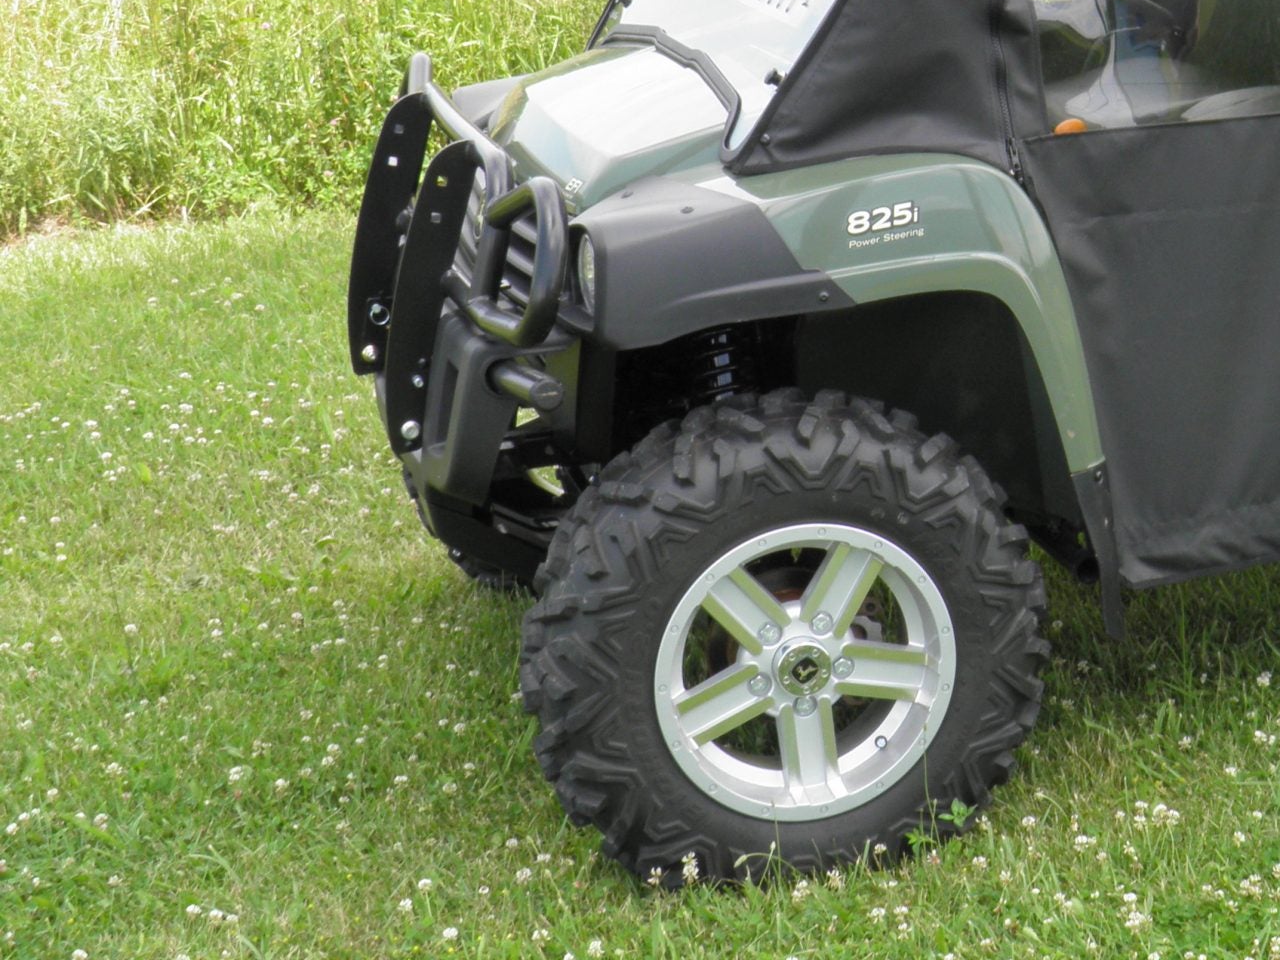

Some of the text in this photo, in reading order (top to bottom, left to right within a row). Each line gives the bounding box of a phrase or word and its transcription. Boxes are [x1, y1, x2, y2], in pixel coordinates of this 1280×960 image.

[847, 201, 919, 235] 825i
[848, 228, 925, 249] Power Steering
